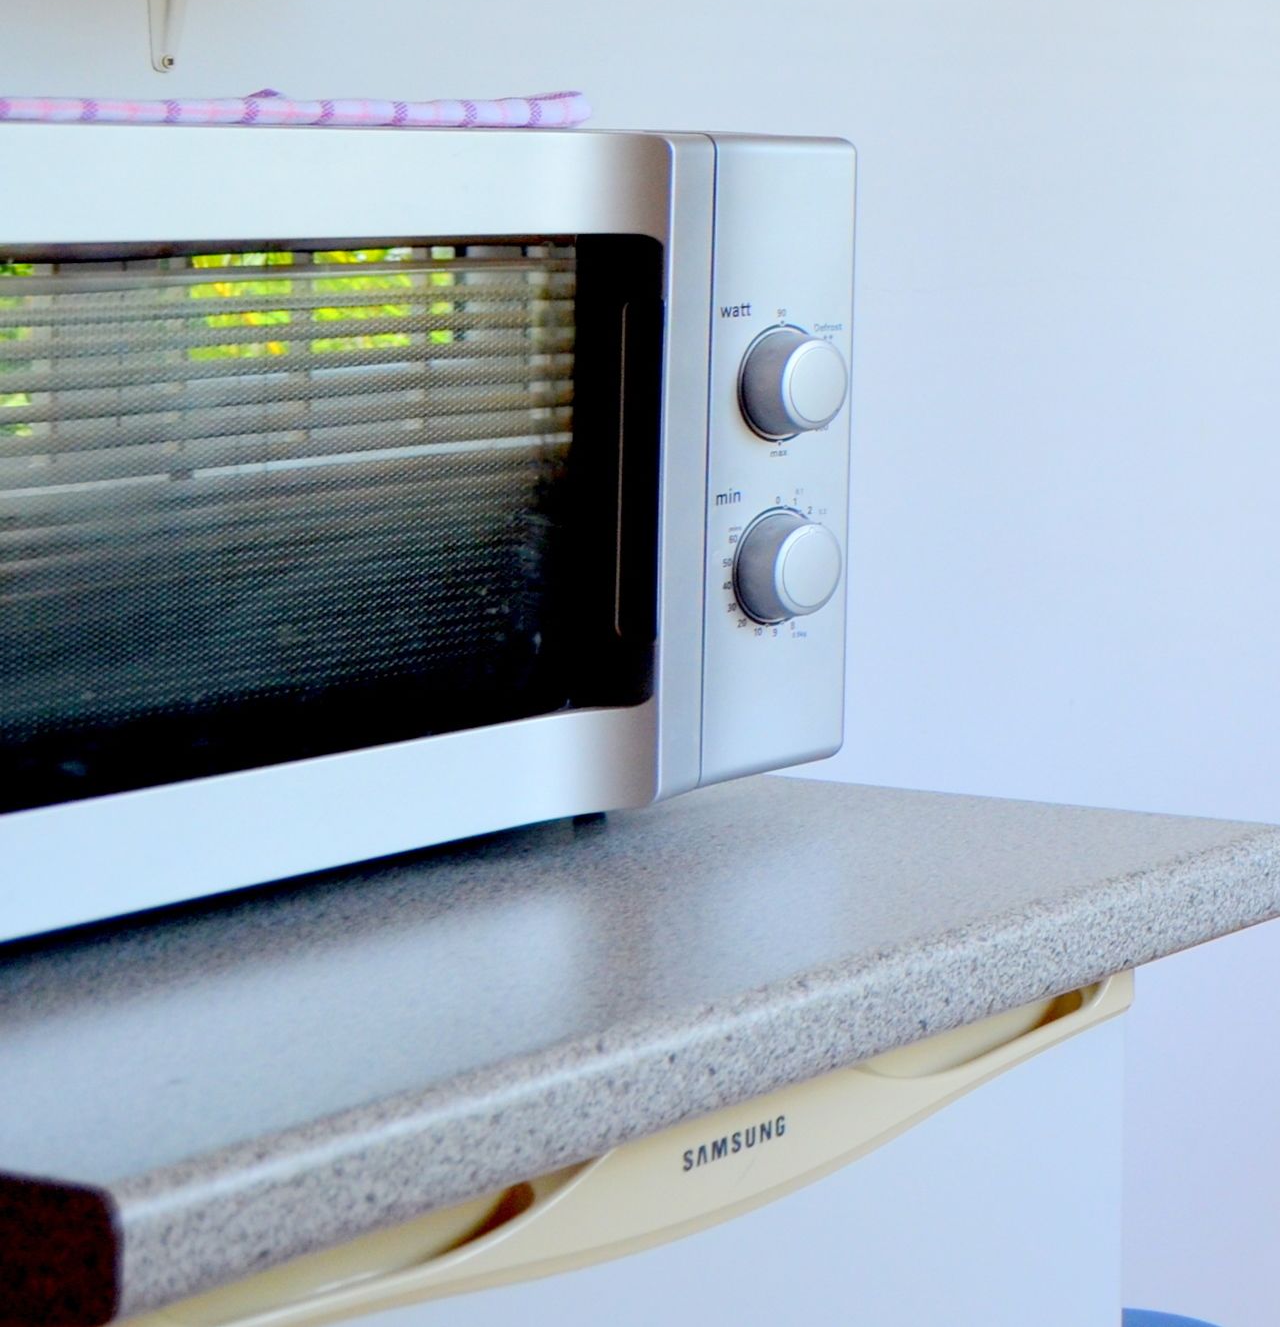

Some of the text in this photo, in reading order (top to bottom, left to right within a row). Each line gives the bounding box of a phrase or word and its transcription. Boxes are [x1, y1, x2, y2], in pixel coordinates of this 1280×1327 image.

[720, 302, 752, 318] watt
[813, 323, 843, 332] Defrost
[769, 450, 788, 458] max
[715, 488, 741, 506] min
[807, 506, 813, 514] 2
[722, 558, 732, 568] 50
[722, 581, 732, 590] 40
[727, 603, 737, 612] 30
[737, 618, 747, 628] 20
[754, 627, 763, 636] 10
[682, 1114, 786, 1172] SAMSUNG
